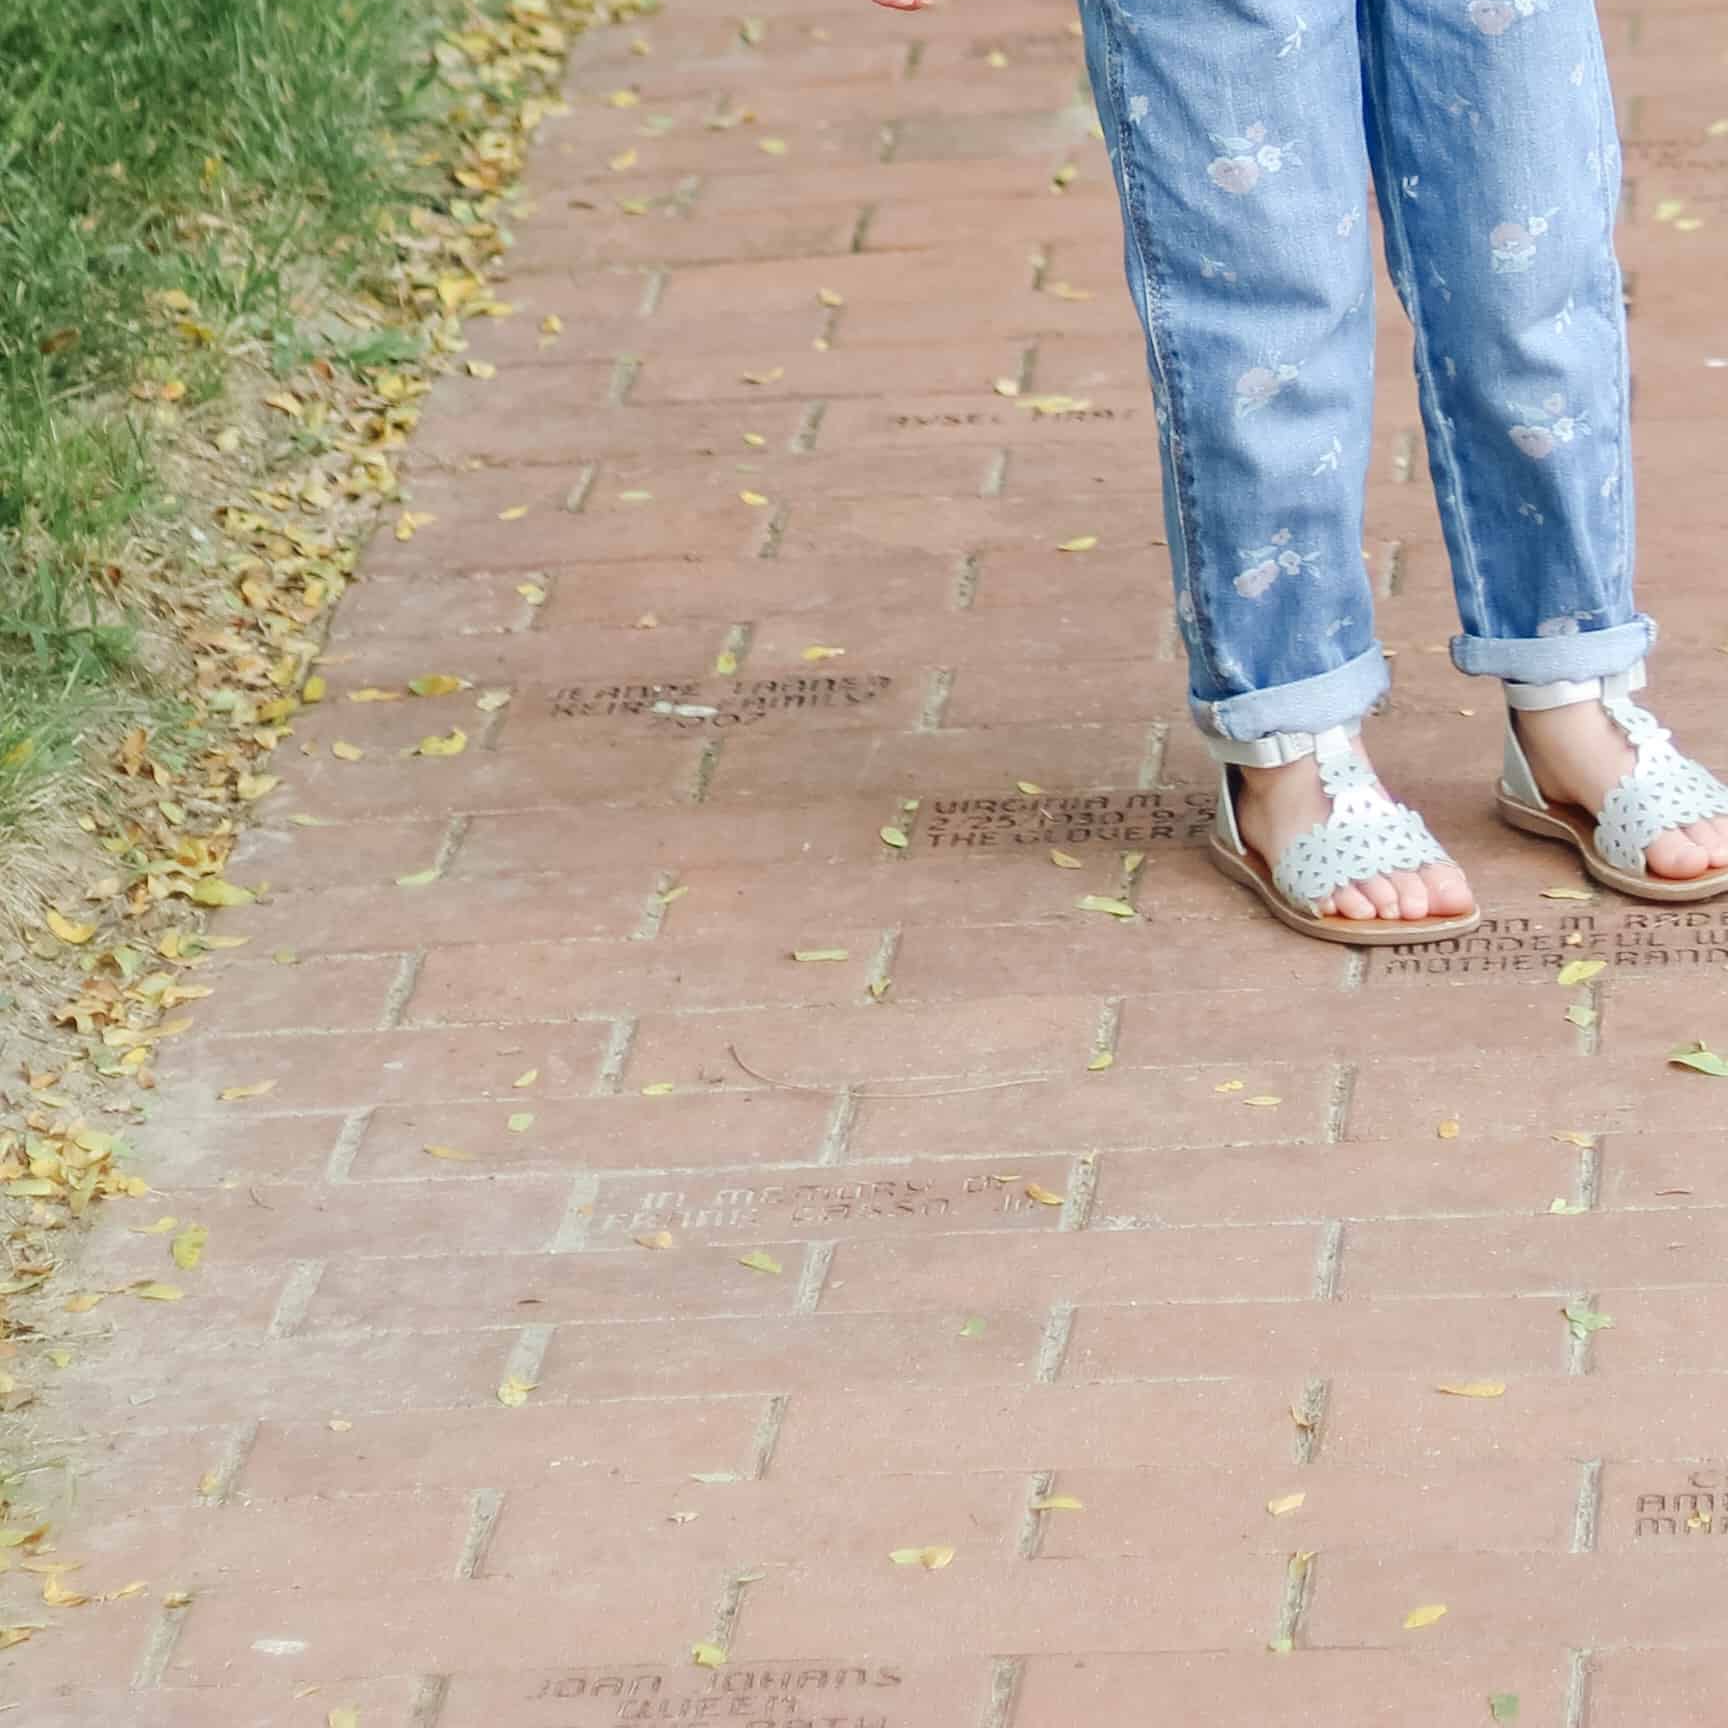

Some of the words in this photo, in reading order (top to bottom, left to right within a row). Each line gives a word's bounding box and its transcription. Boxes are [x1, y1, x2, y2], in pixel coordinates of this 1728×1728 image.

[1127, 794, 1161, 808] M
[927, 831, 1000, 847] THE
[1560, 915, 1595, 930] M
[1385, 953, 1564, 974] MOTHER
